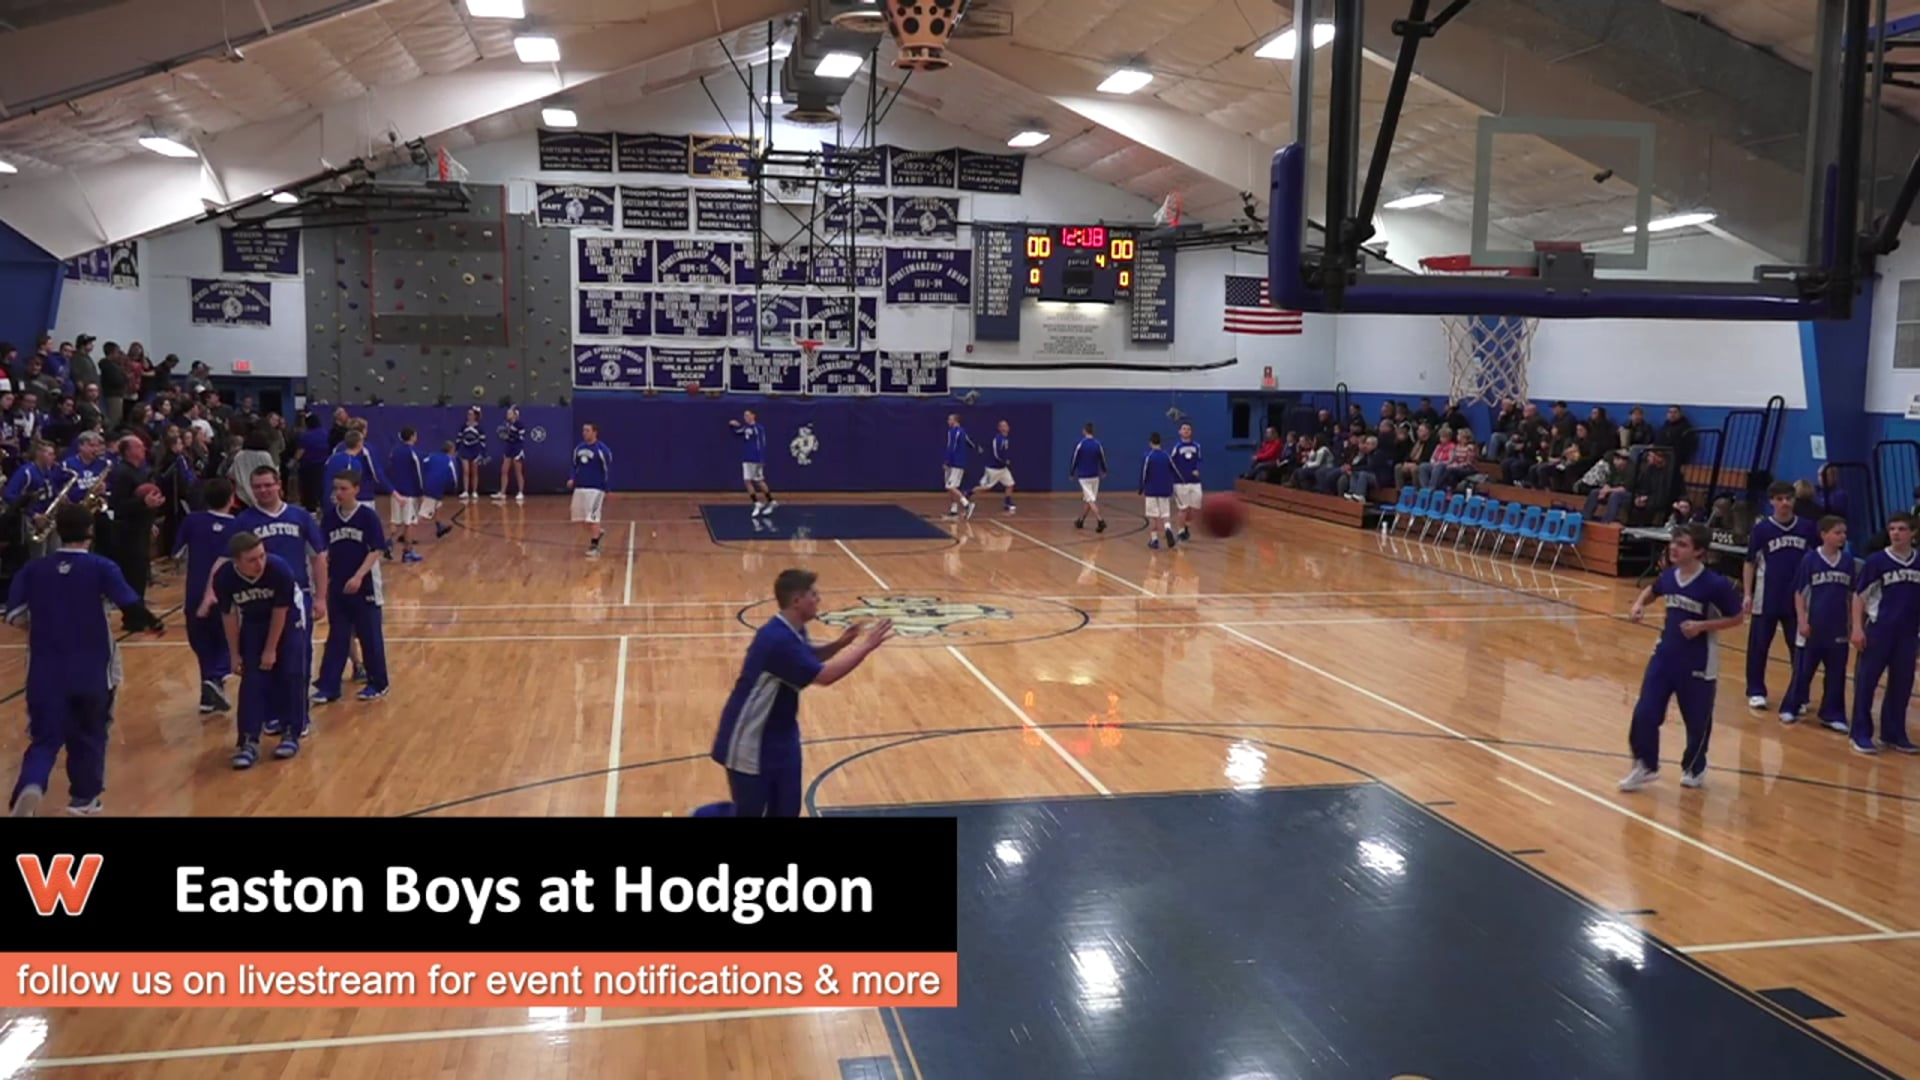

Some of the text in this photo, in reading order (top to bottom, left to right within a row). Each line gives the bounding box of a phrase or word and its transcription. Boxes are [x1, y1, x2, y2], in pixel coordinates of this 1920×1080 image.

[1062, 226, 1104, 248] 12:08
[1027, 236, 1051, 258] 00
[1111, 239, 1134, 260] 00
[1095, 254, 1105, 269] 4
[888, 262, 969, 287] SPORTSMANSHIP AWARD
[1029, 267, 1041, 284] 0
[1119, 271, 1129, 287] 0
[254, 522, 300, 538] EASTON
[328, 526, 363, 543] EASTON
[1768, 535, 1807, 553] EASTON
[1811, 571, 1851, 587] EASTON
[232, 588, 275, 604] EASTON
